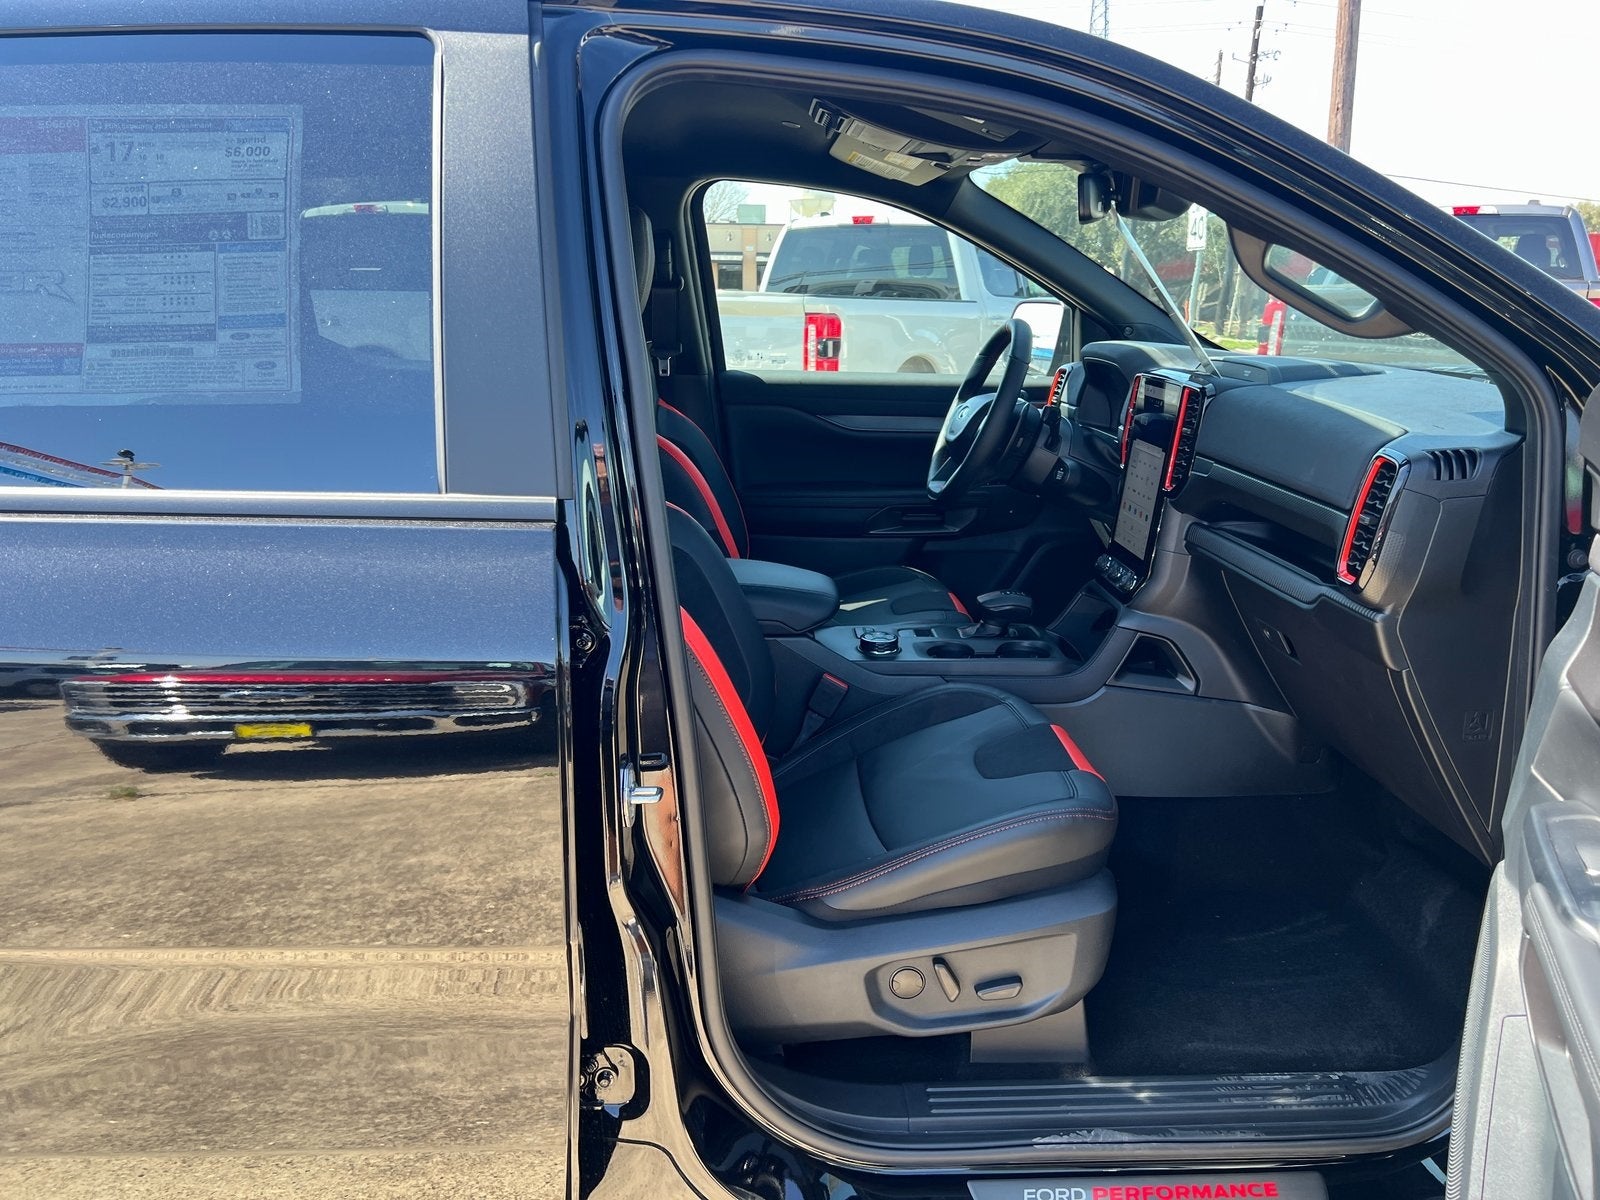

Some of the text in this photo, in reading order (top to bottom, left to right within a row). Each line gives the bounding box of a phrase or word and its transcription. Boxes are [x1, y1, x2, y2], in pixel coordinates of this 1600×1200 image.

[104, 141, 134, 162] 17
[225, 146, 271, 158] $6,000
[102, 196, 147, 209] $2,900
[1190, 215, 1205, 241] 40
[1023, 1182, 1279, 1200] FORD PERFORMANCE
